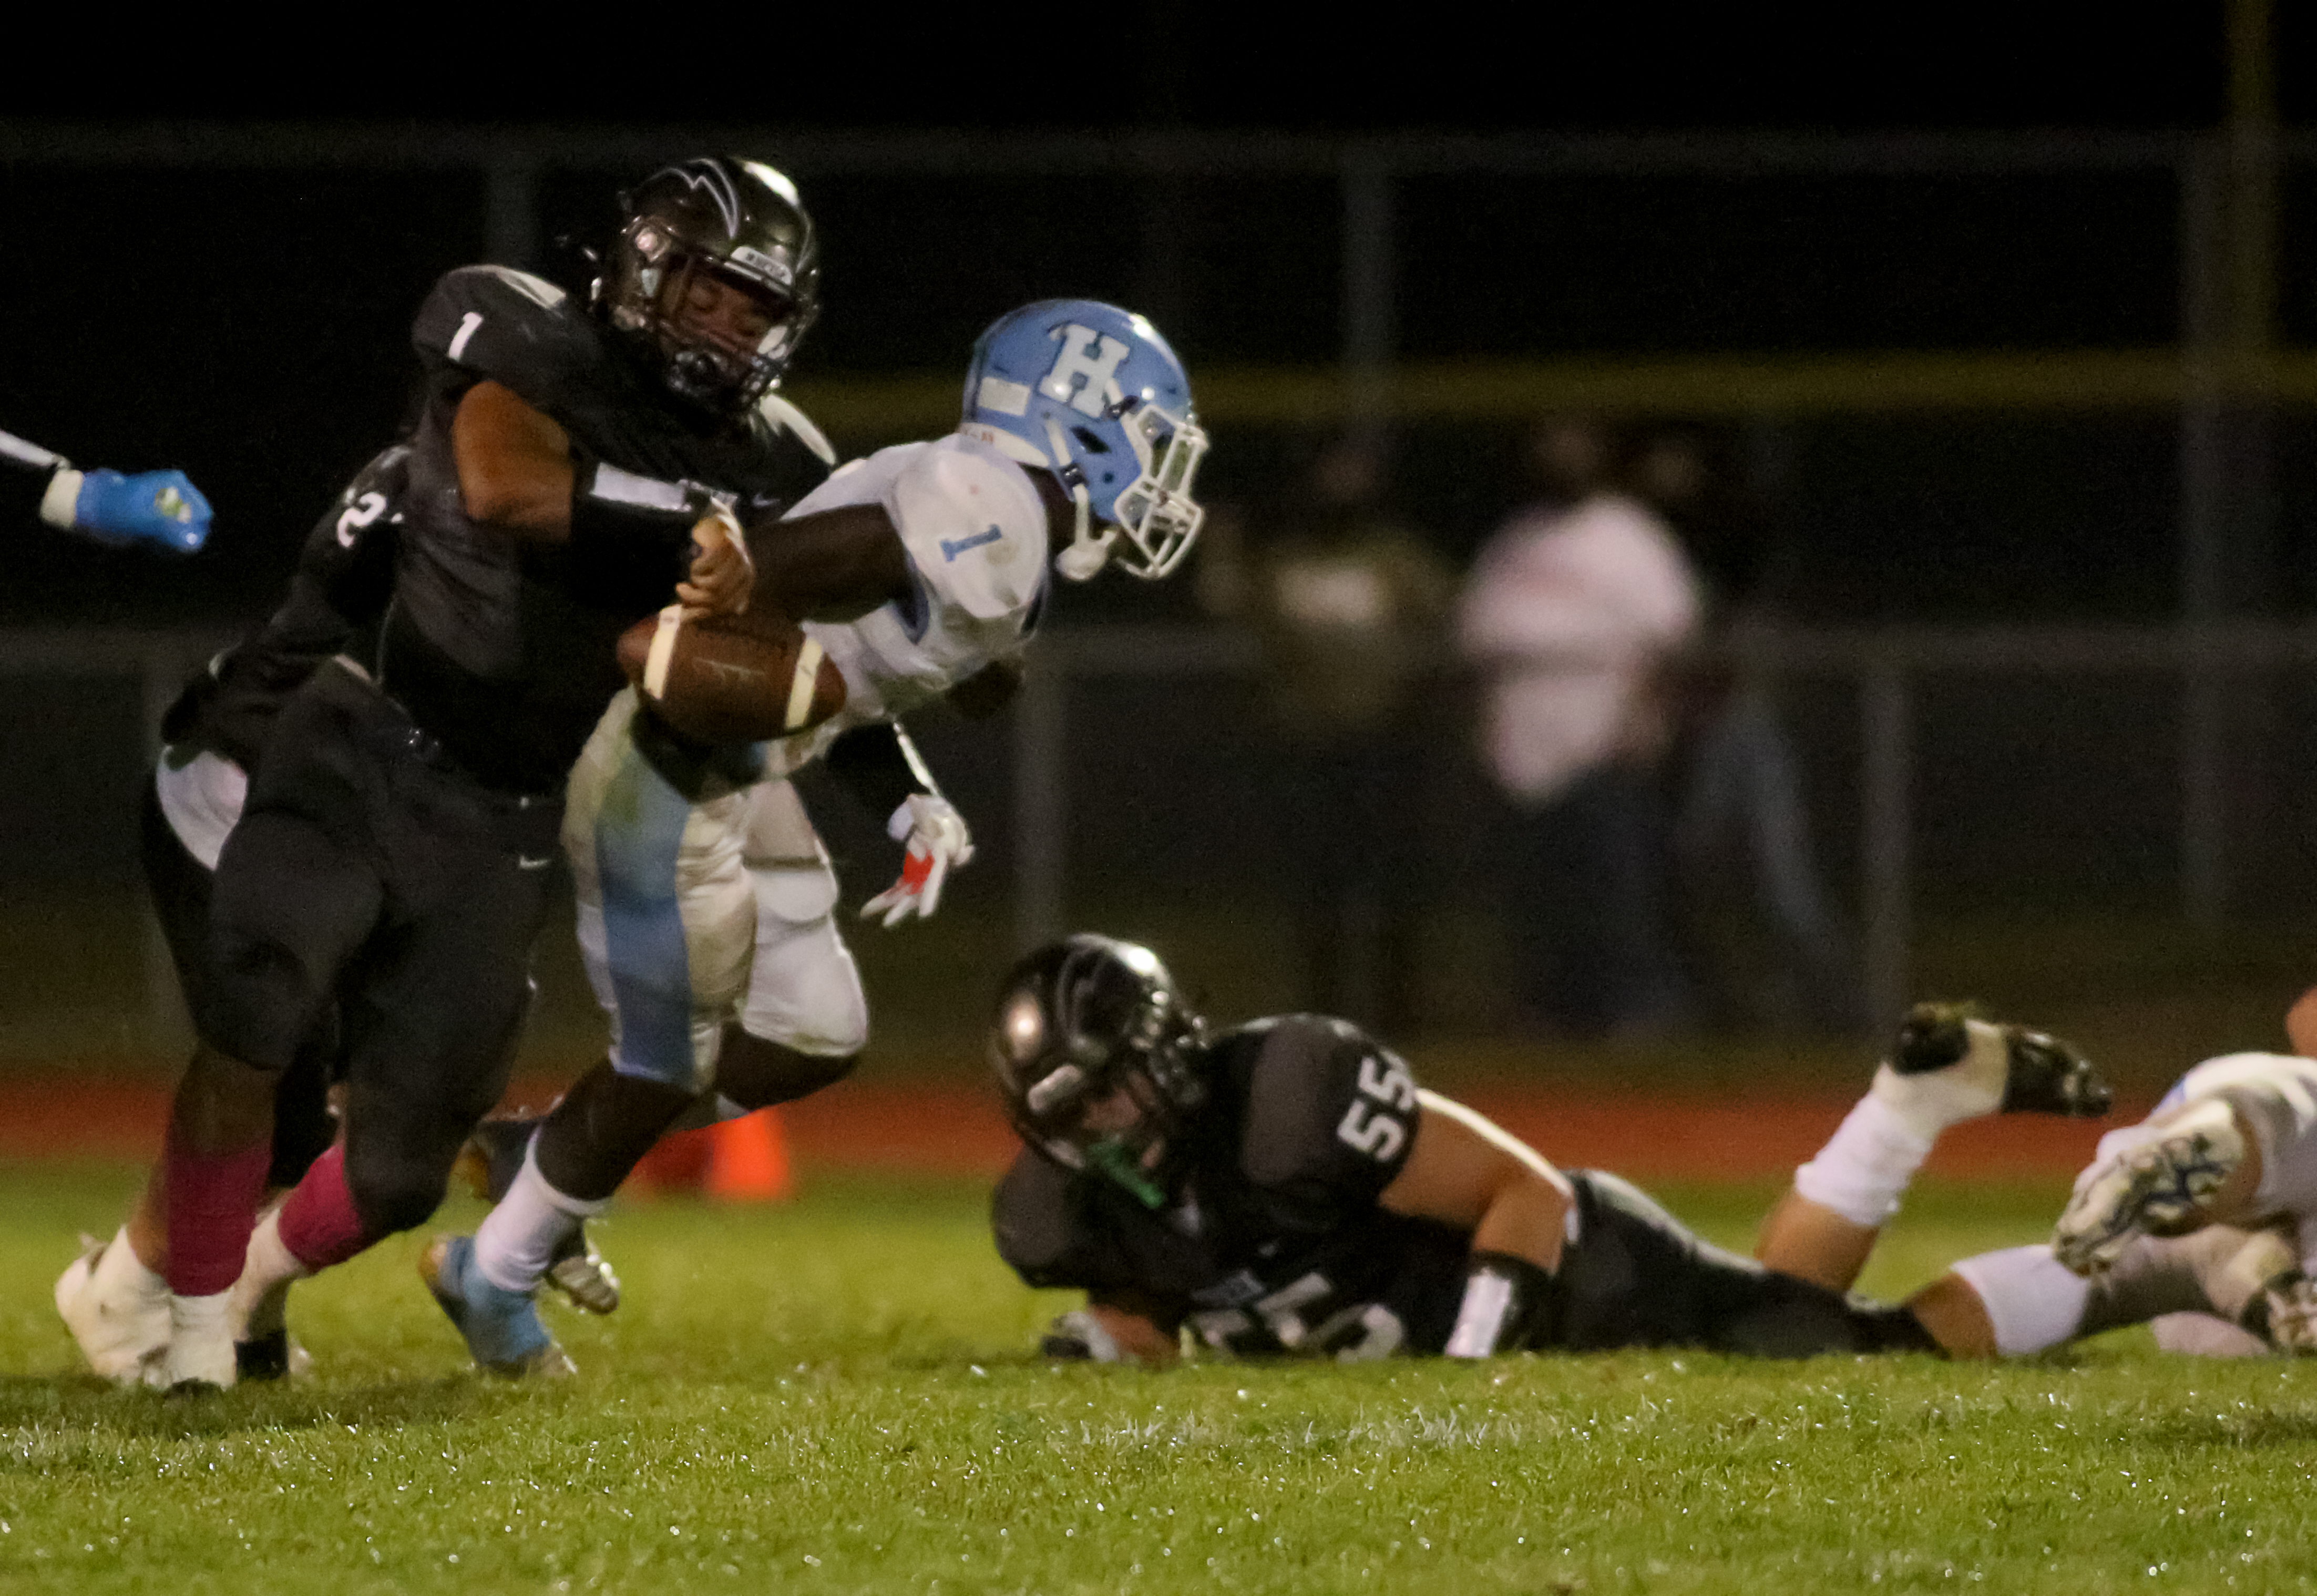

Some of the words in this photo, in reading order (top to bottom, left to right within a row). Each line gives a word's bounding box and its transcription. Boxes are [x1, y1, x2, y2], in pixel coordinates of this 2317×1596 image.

[448, 311, 483, 362] 1
[1040, 324, 1130, 418] H
[939, 524, 1002, 562] 1
[1337, 1051, 1413, 1163] 55
